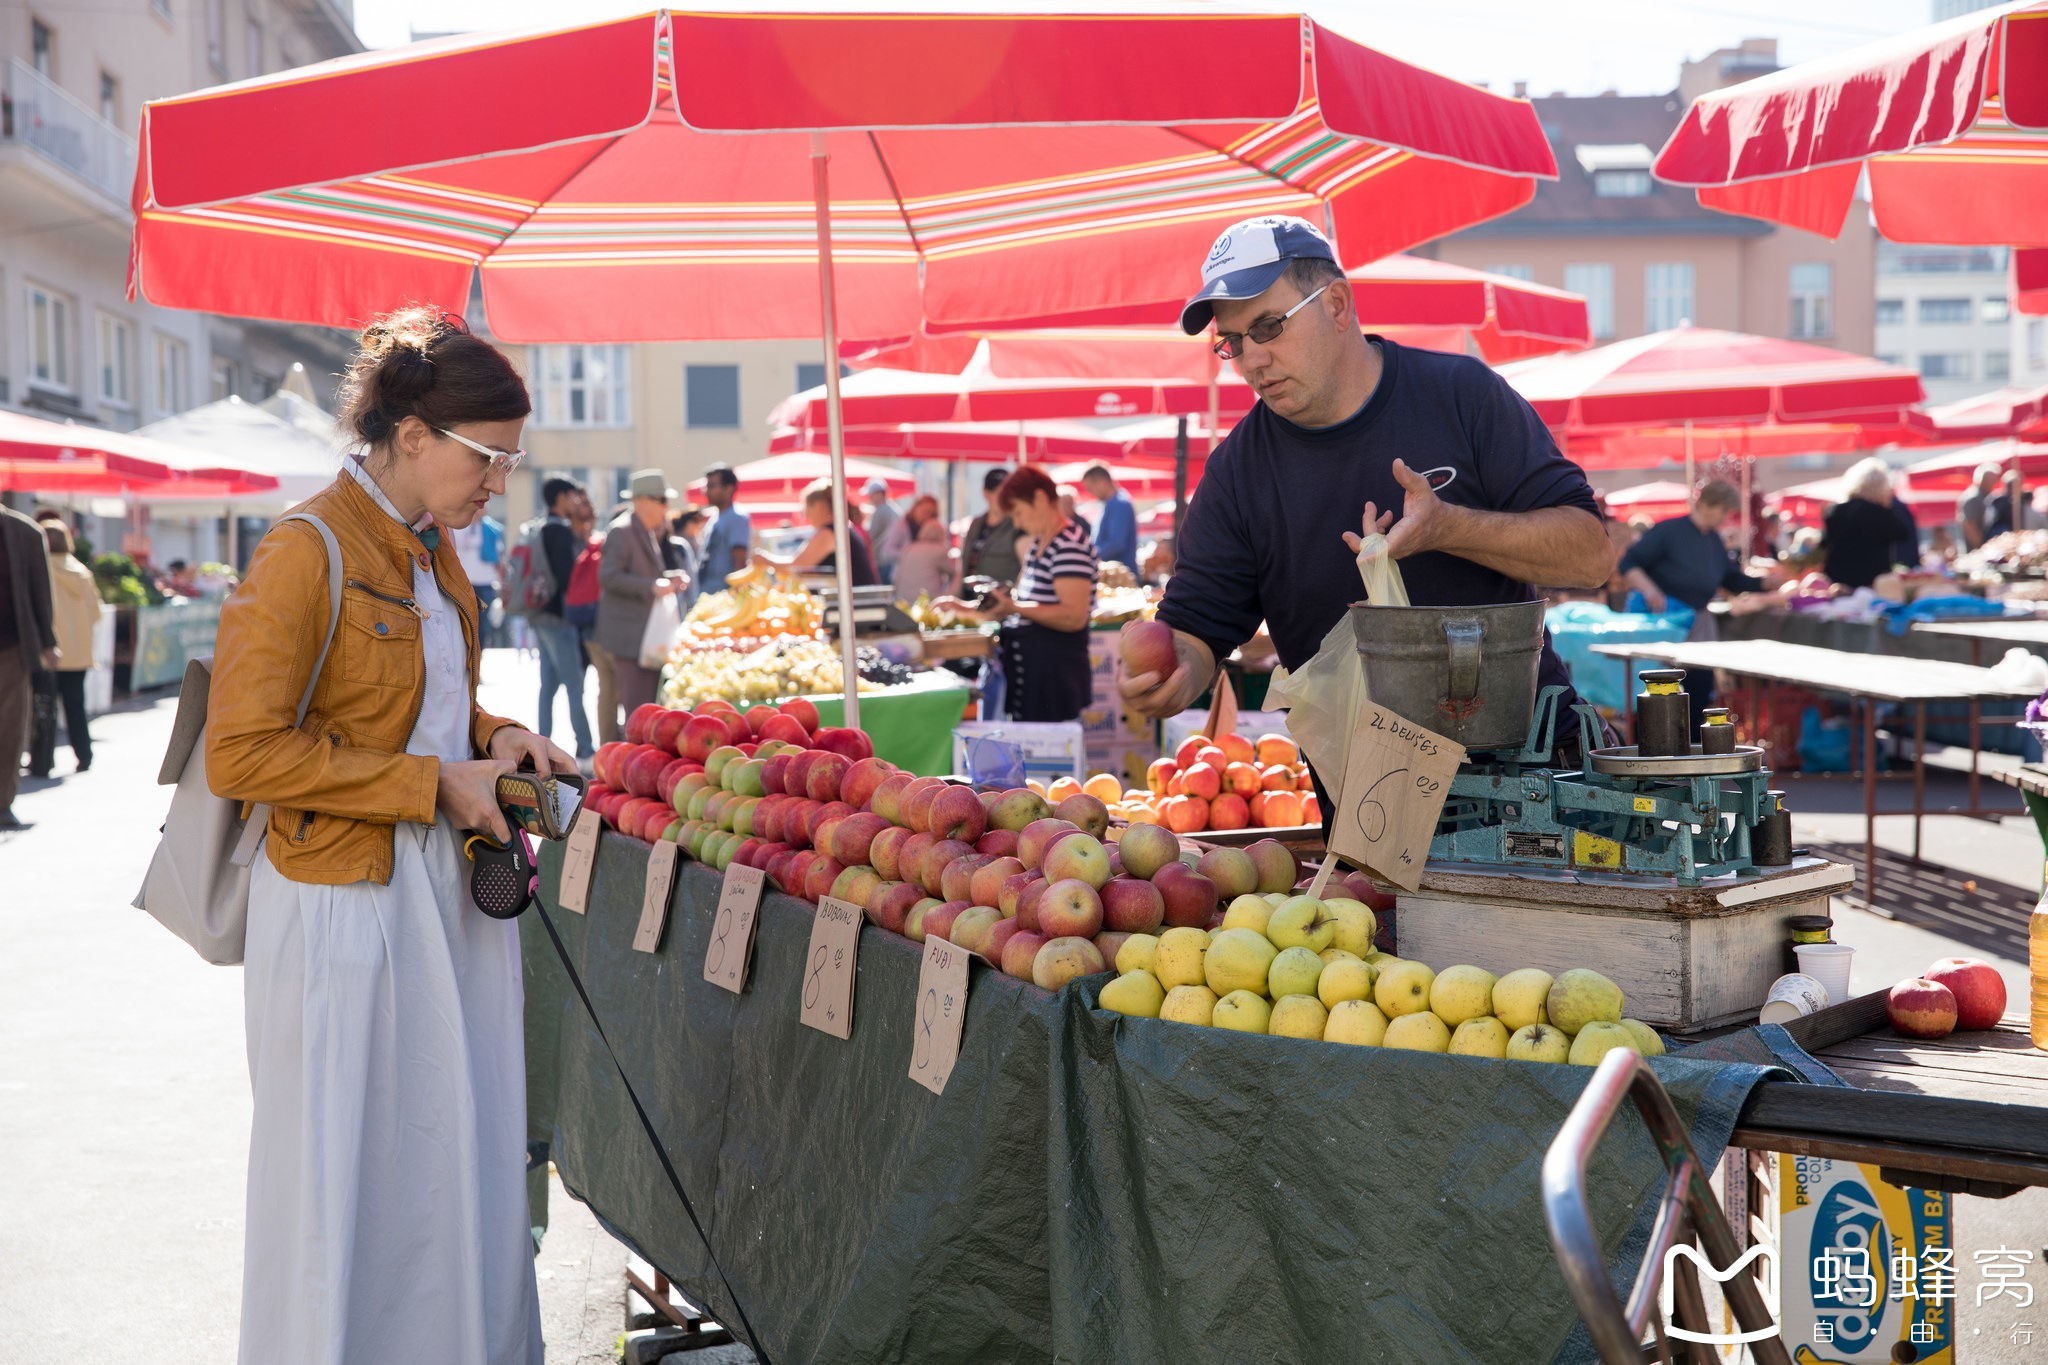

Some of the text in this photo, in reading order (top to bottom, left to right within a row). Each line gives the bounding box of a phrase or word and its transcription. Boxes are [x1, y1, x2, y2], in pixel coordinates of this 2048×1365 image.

[1357, 769, 1409, 842] 6
[708, 908, 732, 974] 8
[805, 945, 828, 1009] 8
[917, 987, 937, 1069] 8
[1816, 1193, 1884, 1341] derby
